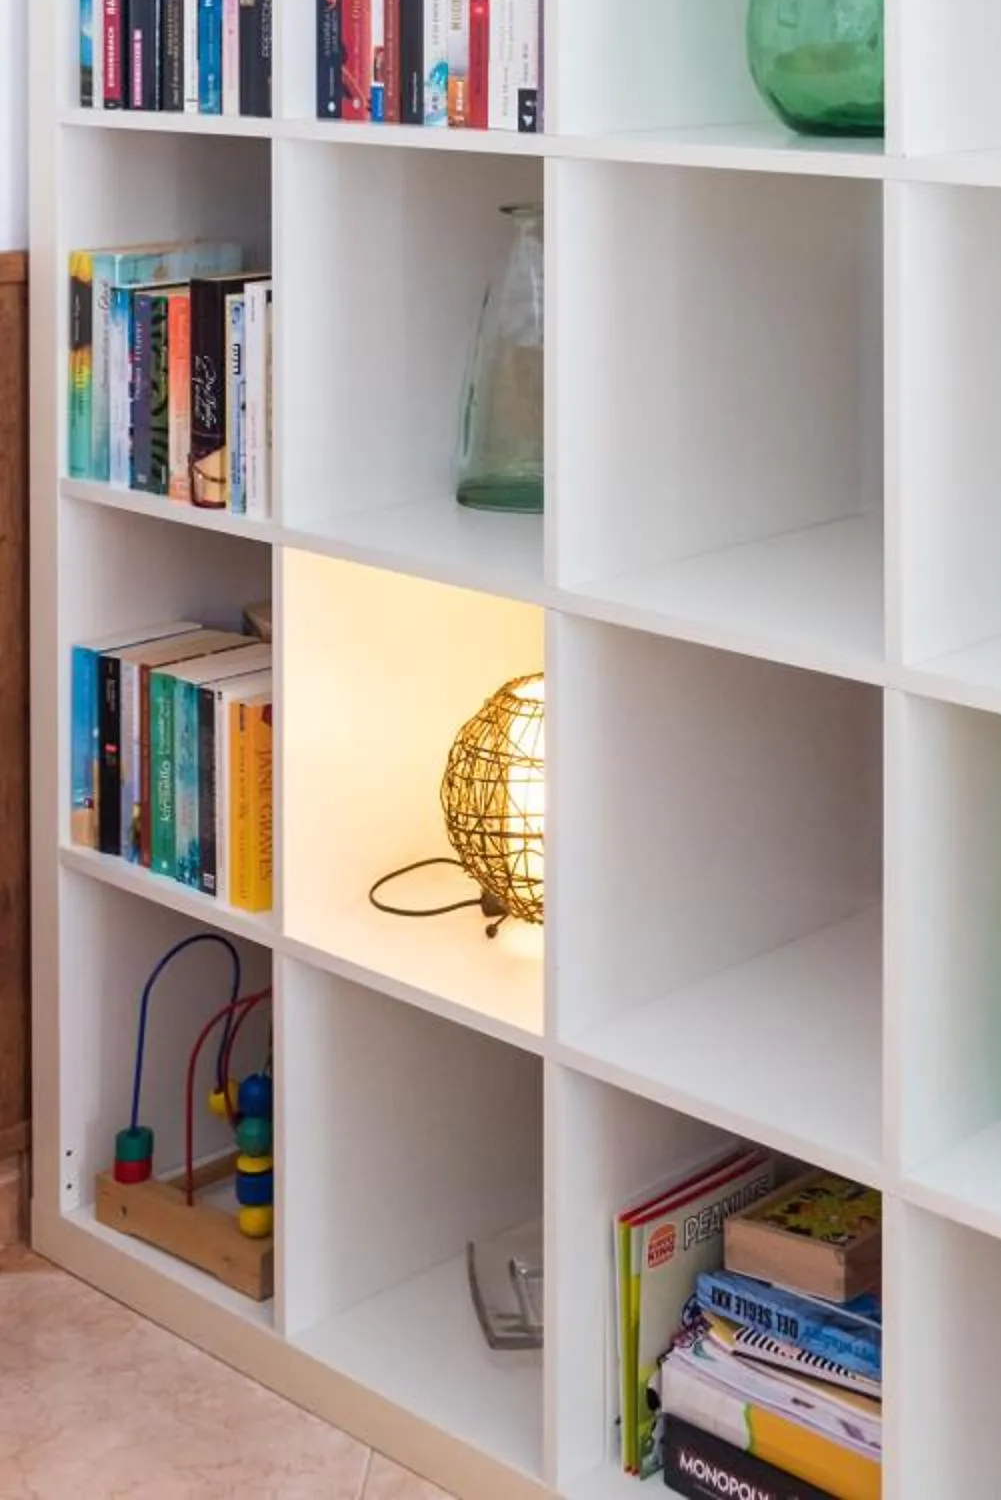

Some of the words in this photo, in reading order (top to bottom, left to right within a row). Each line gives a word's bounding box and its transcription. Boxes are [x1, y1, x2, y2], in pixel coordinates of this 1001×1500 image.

[258, 748, 272, 797] JANE
[258, 802, 272, 883] GRAVES
[711, 1285, 733, 1311] XXI
[777, 1312, 800, 1341] DEL
